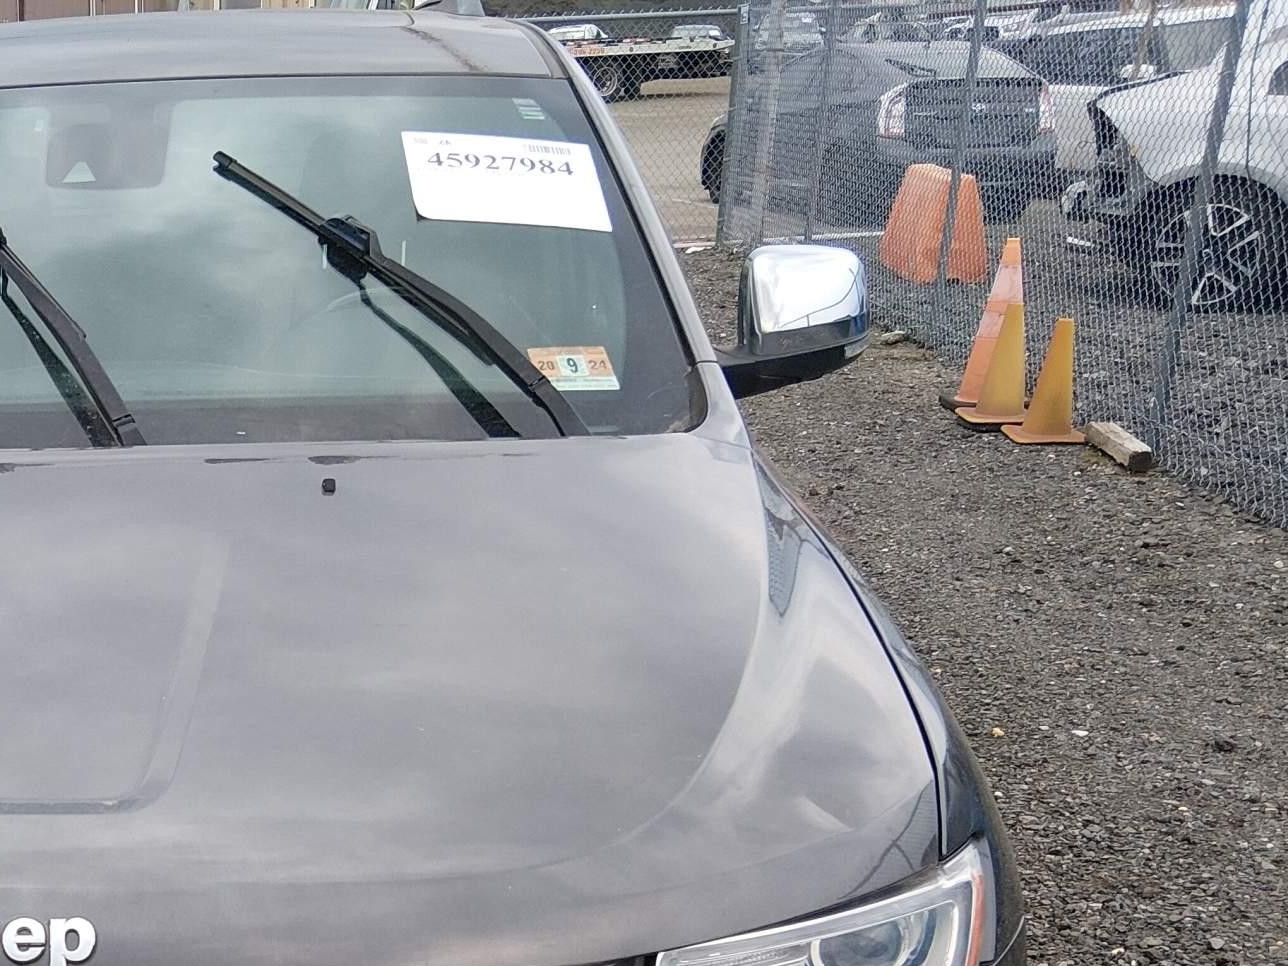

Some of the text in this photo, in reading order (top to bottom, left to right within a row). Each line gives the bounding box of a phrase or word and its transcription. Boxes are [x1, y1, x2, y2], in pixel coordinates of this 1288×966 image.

[427, 152, 575, 176] 45927984
[537, 357, 608, 373] 20 9 24
